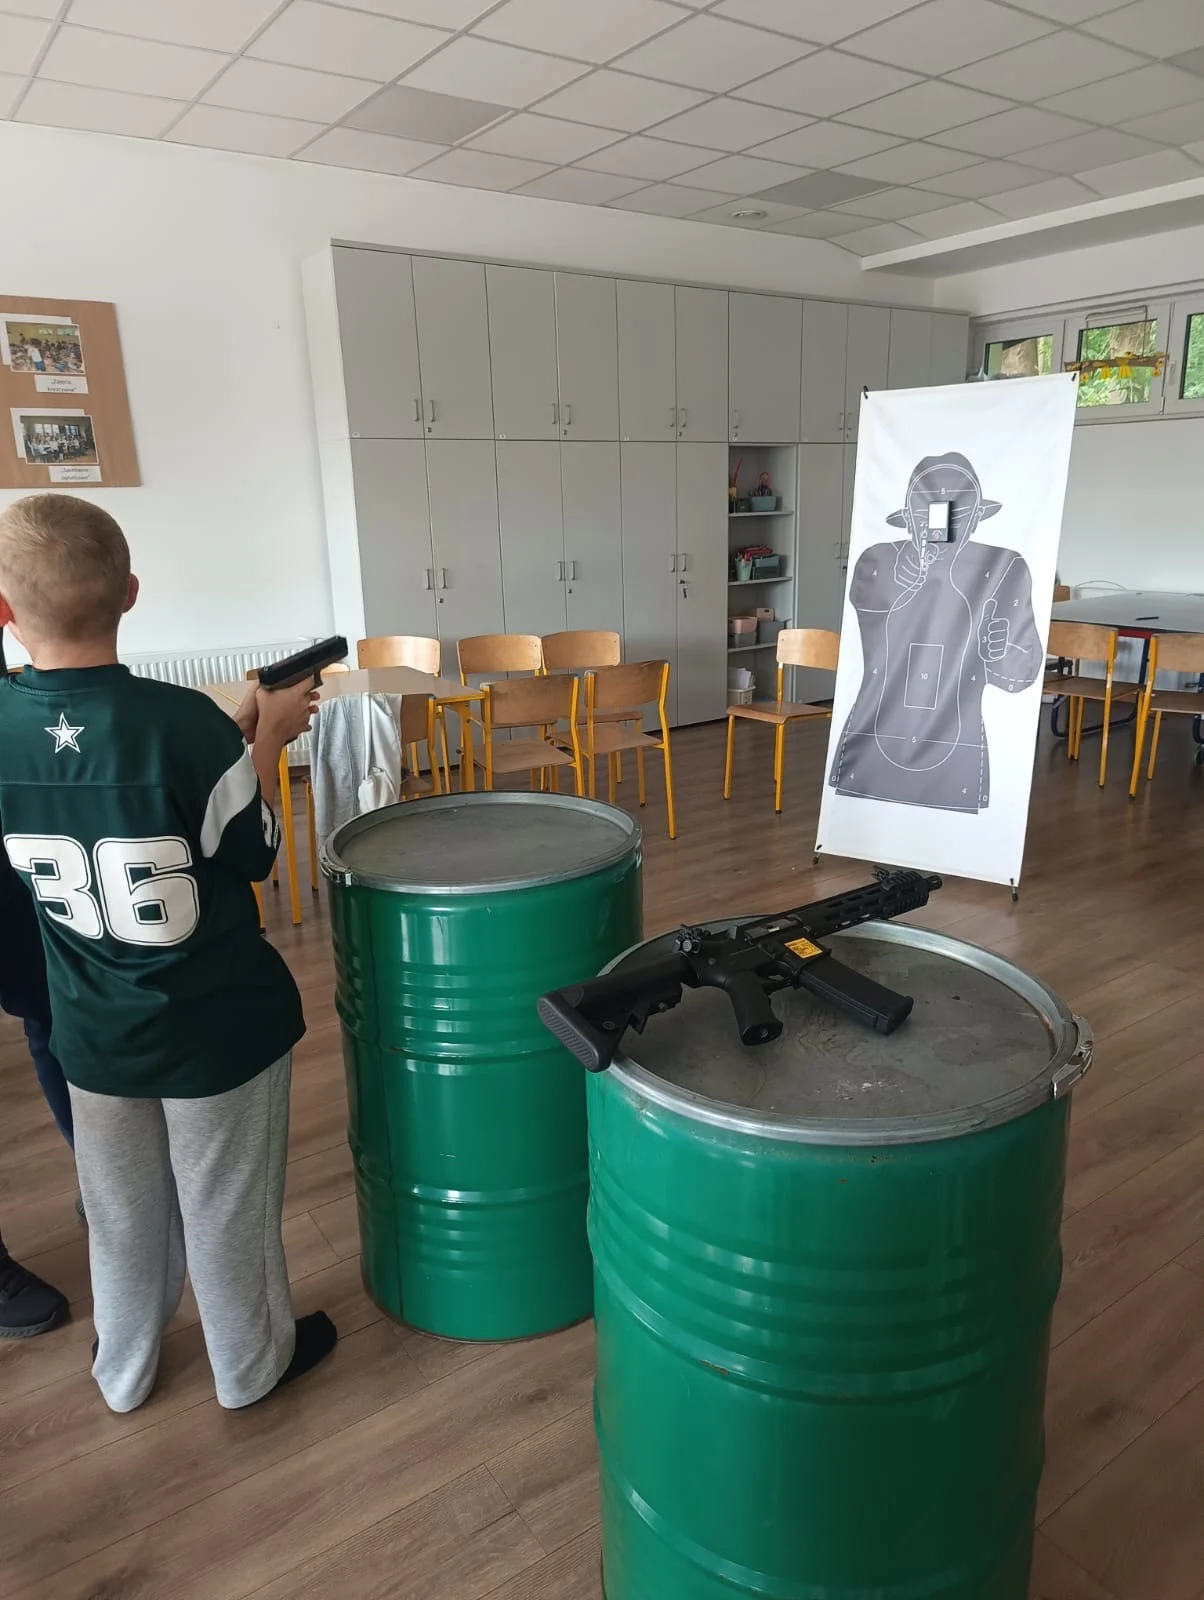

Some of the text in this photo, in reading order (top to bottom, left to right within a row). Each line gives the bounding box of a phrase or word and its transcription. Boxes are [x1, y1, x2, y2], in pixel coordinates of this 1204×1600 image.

[984, 571, 990, 579] 4
[1013, 599, 1019, 607] 2
[872, 667, 878, 675] 4
[920, 672, 929, 680] 10
[961, 787, 967, 795] 4
[982, 794, 988, 802] 0
[3, 833, 200, 947] 36
